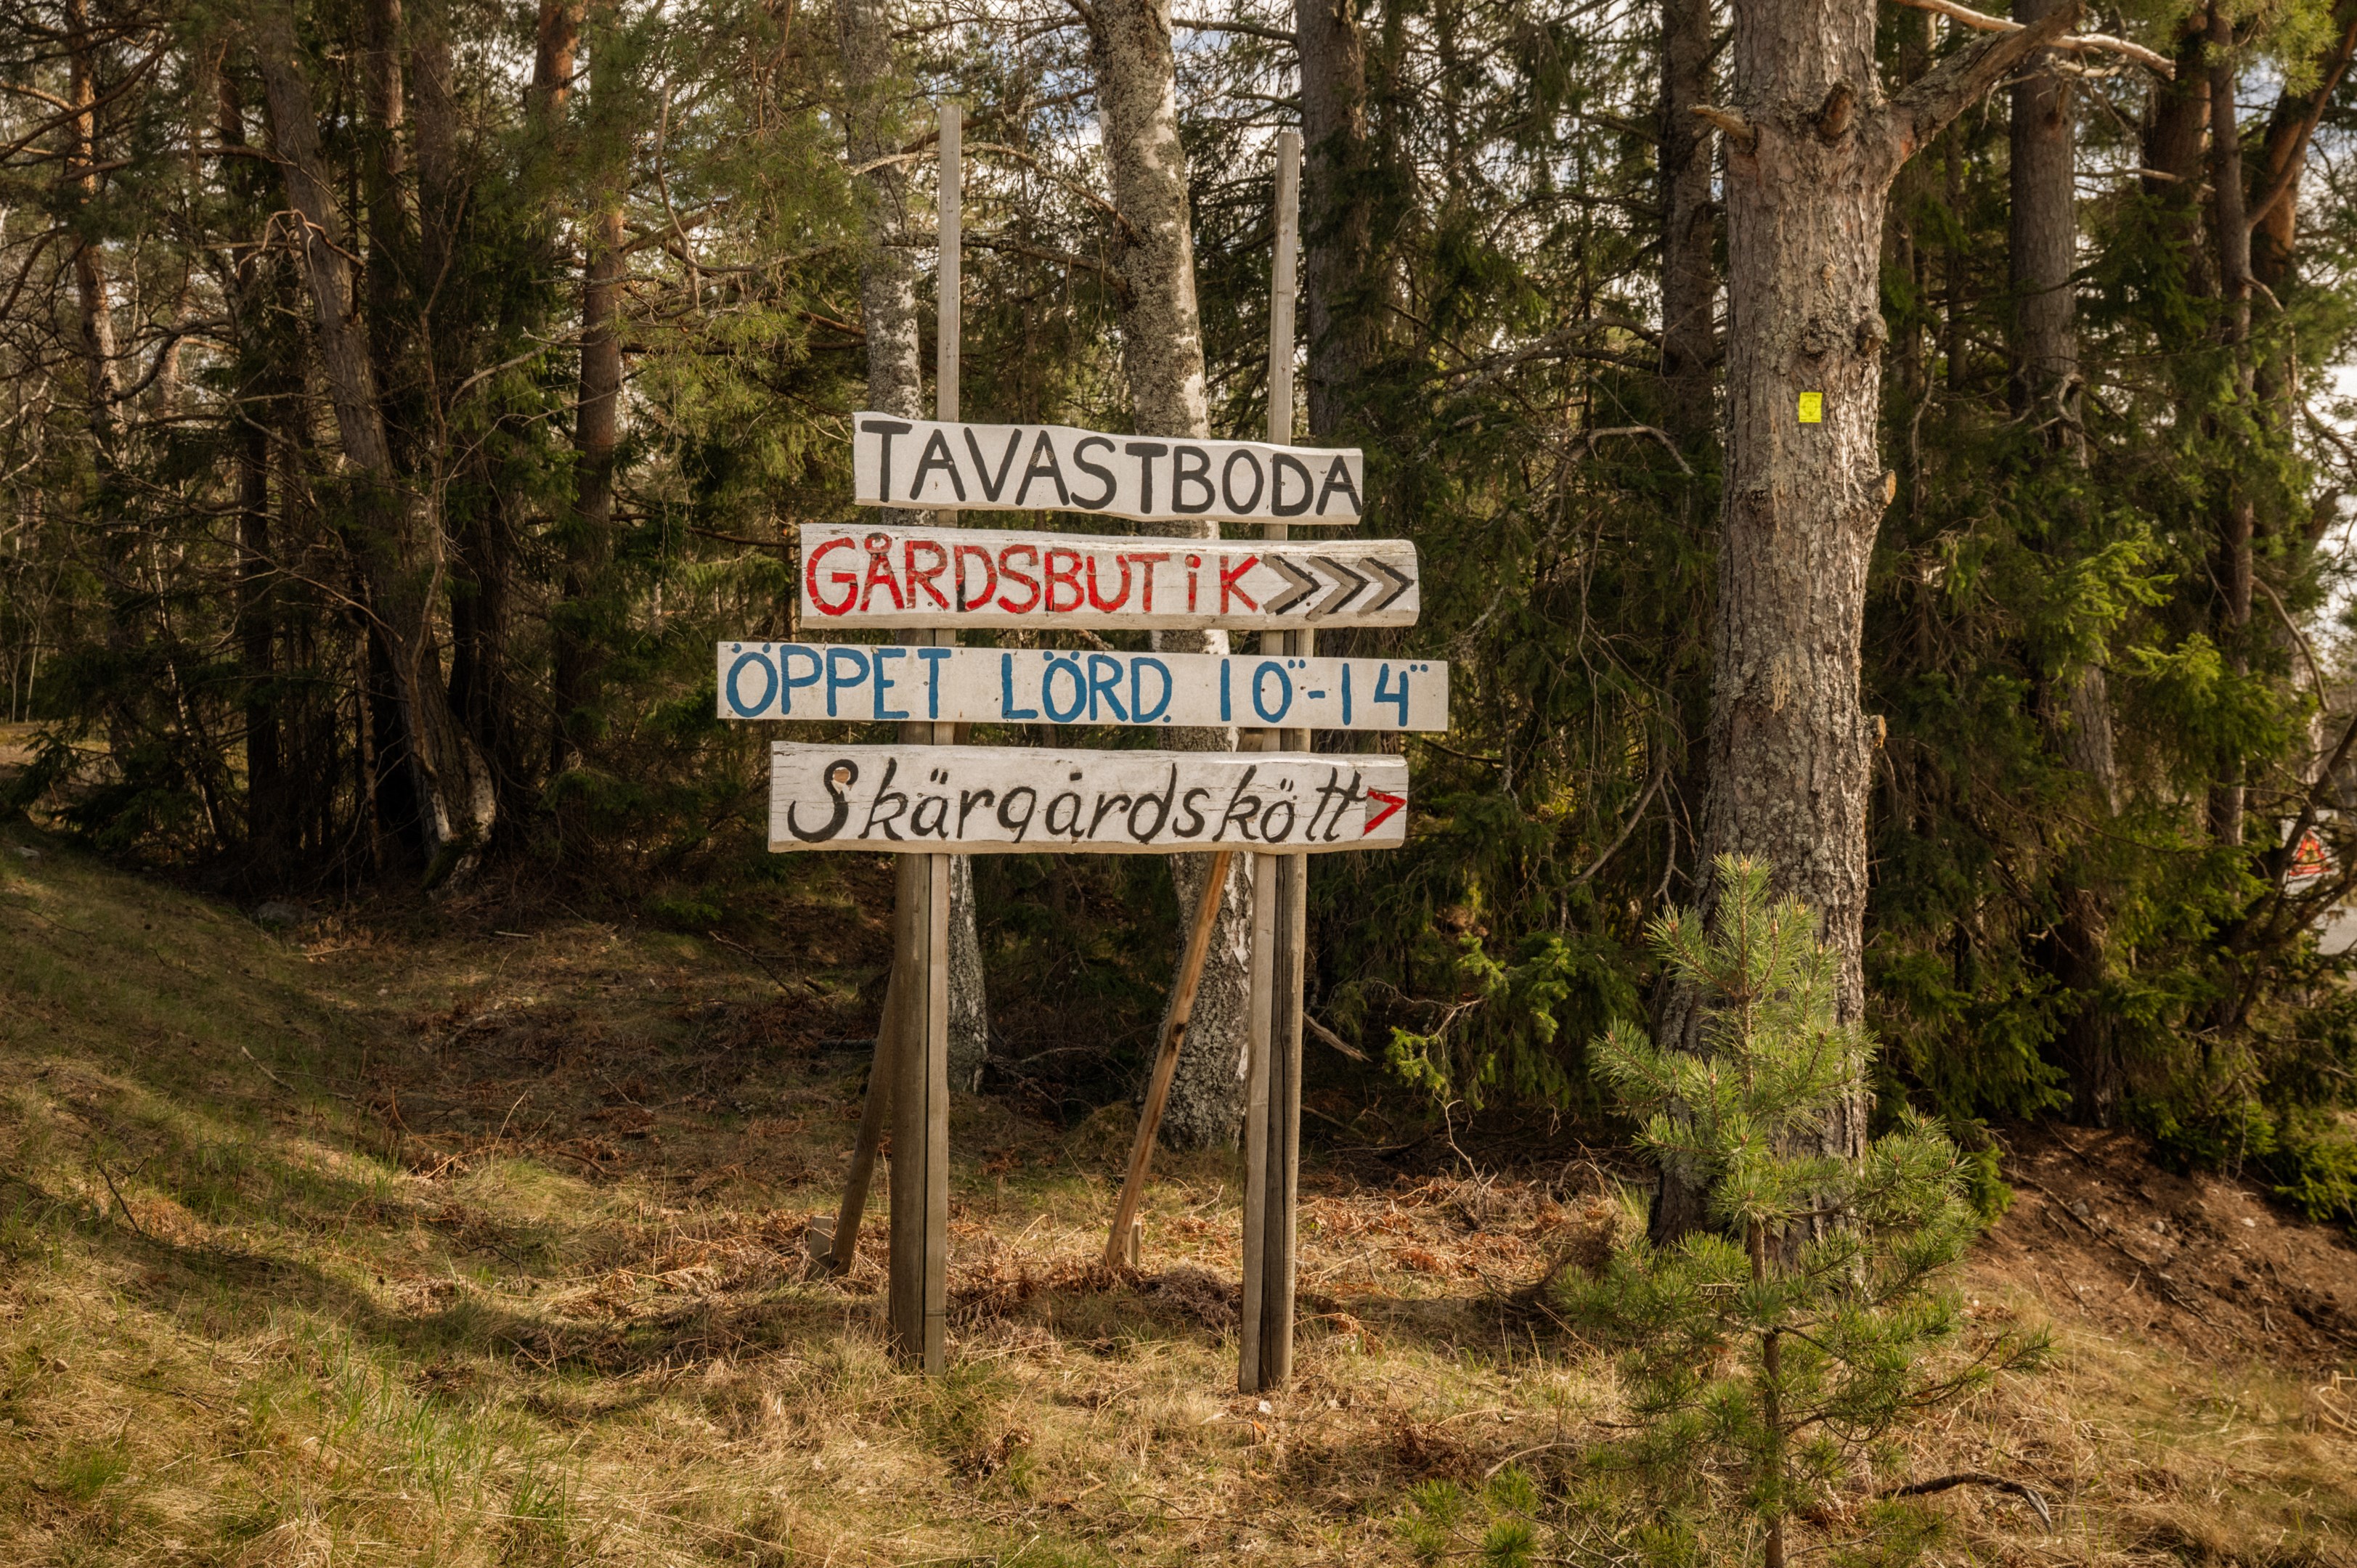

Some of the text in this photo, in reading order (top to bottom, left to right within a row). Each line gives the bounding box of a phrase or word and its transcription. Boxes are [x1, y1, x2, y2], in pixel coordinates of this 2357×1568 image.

[861, 420, 1362, 517] TAVASTBODA
[726, 642, 951, 719] ÖPPET
[1001, 650, 1172, 723] LÖRD.
[786, 757, 1369, 844] Skärgårdskött
